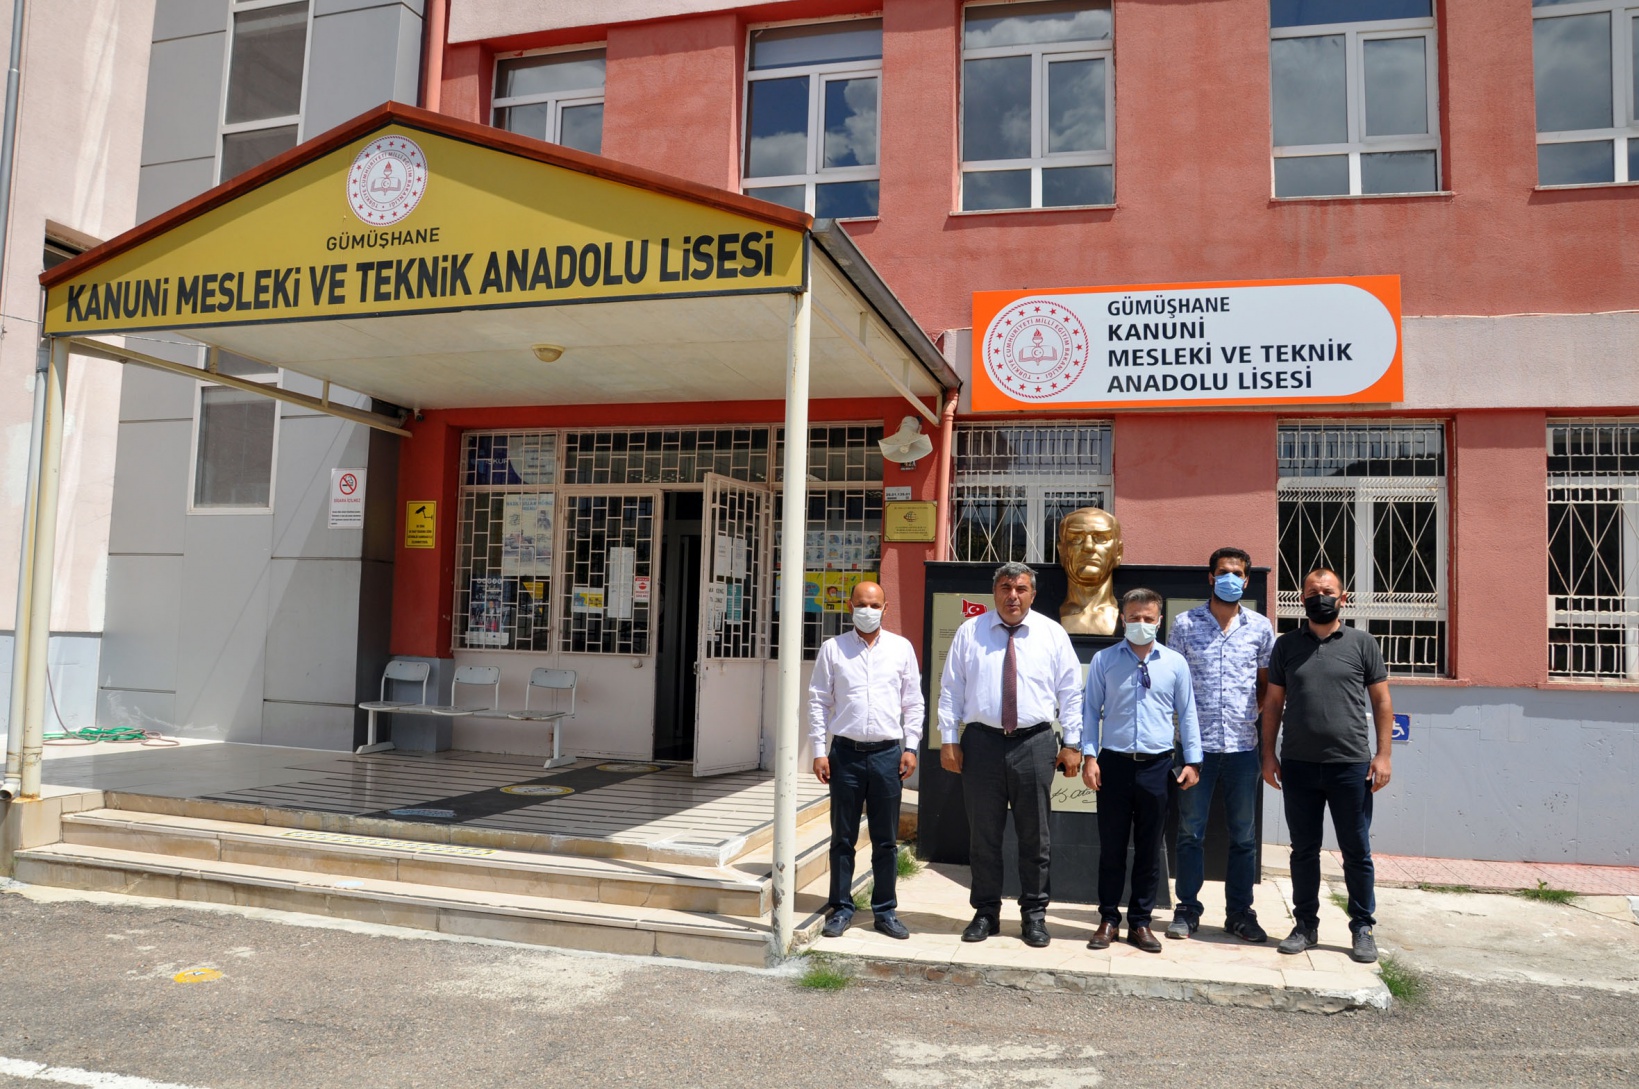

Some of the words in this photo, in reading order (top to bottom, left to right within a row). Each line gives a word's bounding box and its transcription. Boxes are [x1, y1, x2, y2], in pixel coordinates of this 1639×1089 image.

[326, 227, 440, 251] GÜMÜŞHANE
[308, 263, 346, 306] VE
[479, 239, 649, 295] ANADOLU
[1107, 296, 1231, 319] GÜMÜŞHANE
[1006, 318, 1034, 358] CUMHURİYETİ
[1054, 324, 1070, 346] EĞİTİM
[1107, 321, 1206, 342] KANUNİ
[1107, 342, 1212, 367] MESLEKİ
[1222, 346, 1252, 365] VE
[1260, 338, 1353, 363] TEKNİK
[1008, 359, 1032, 380] TÜRKİYE
[1107, 372, 1229, 393] ANADOLU
[1238, 366, 1312, 390] LİSESİ
